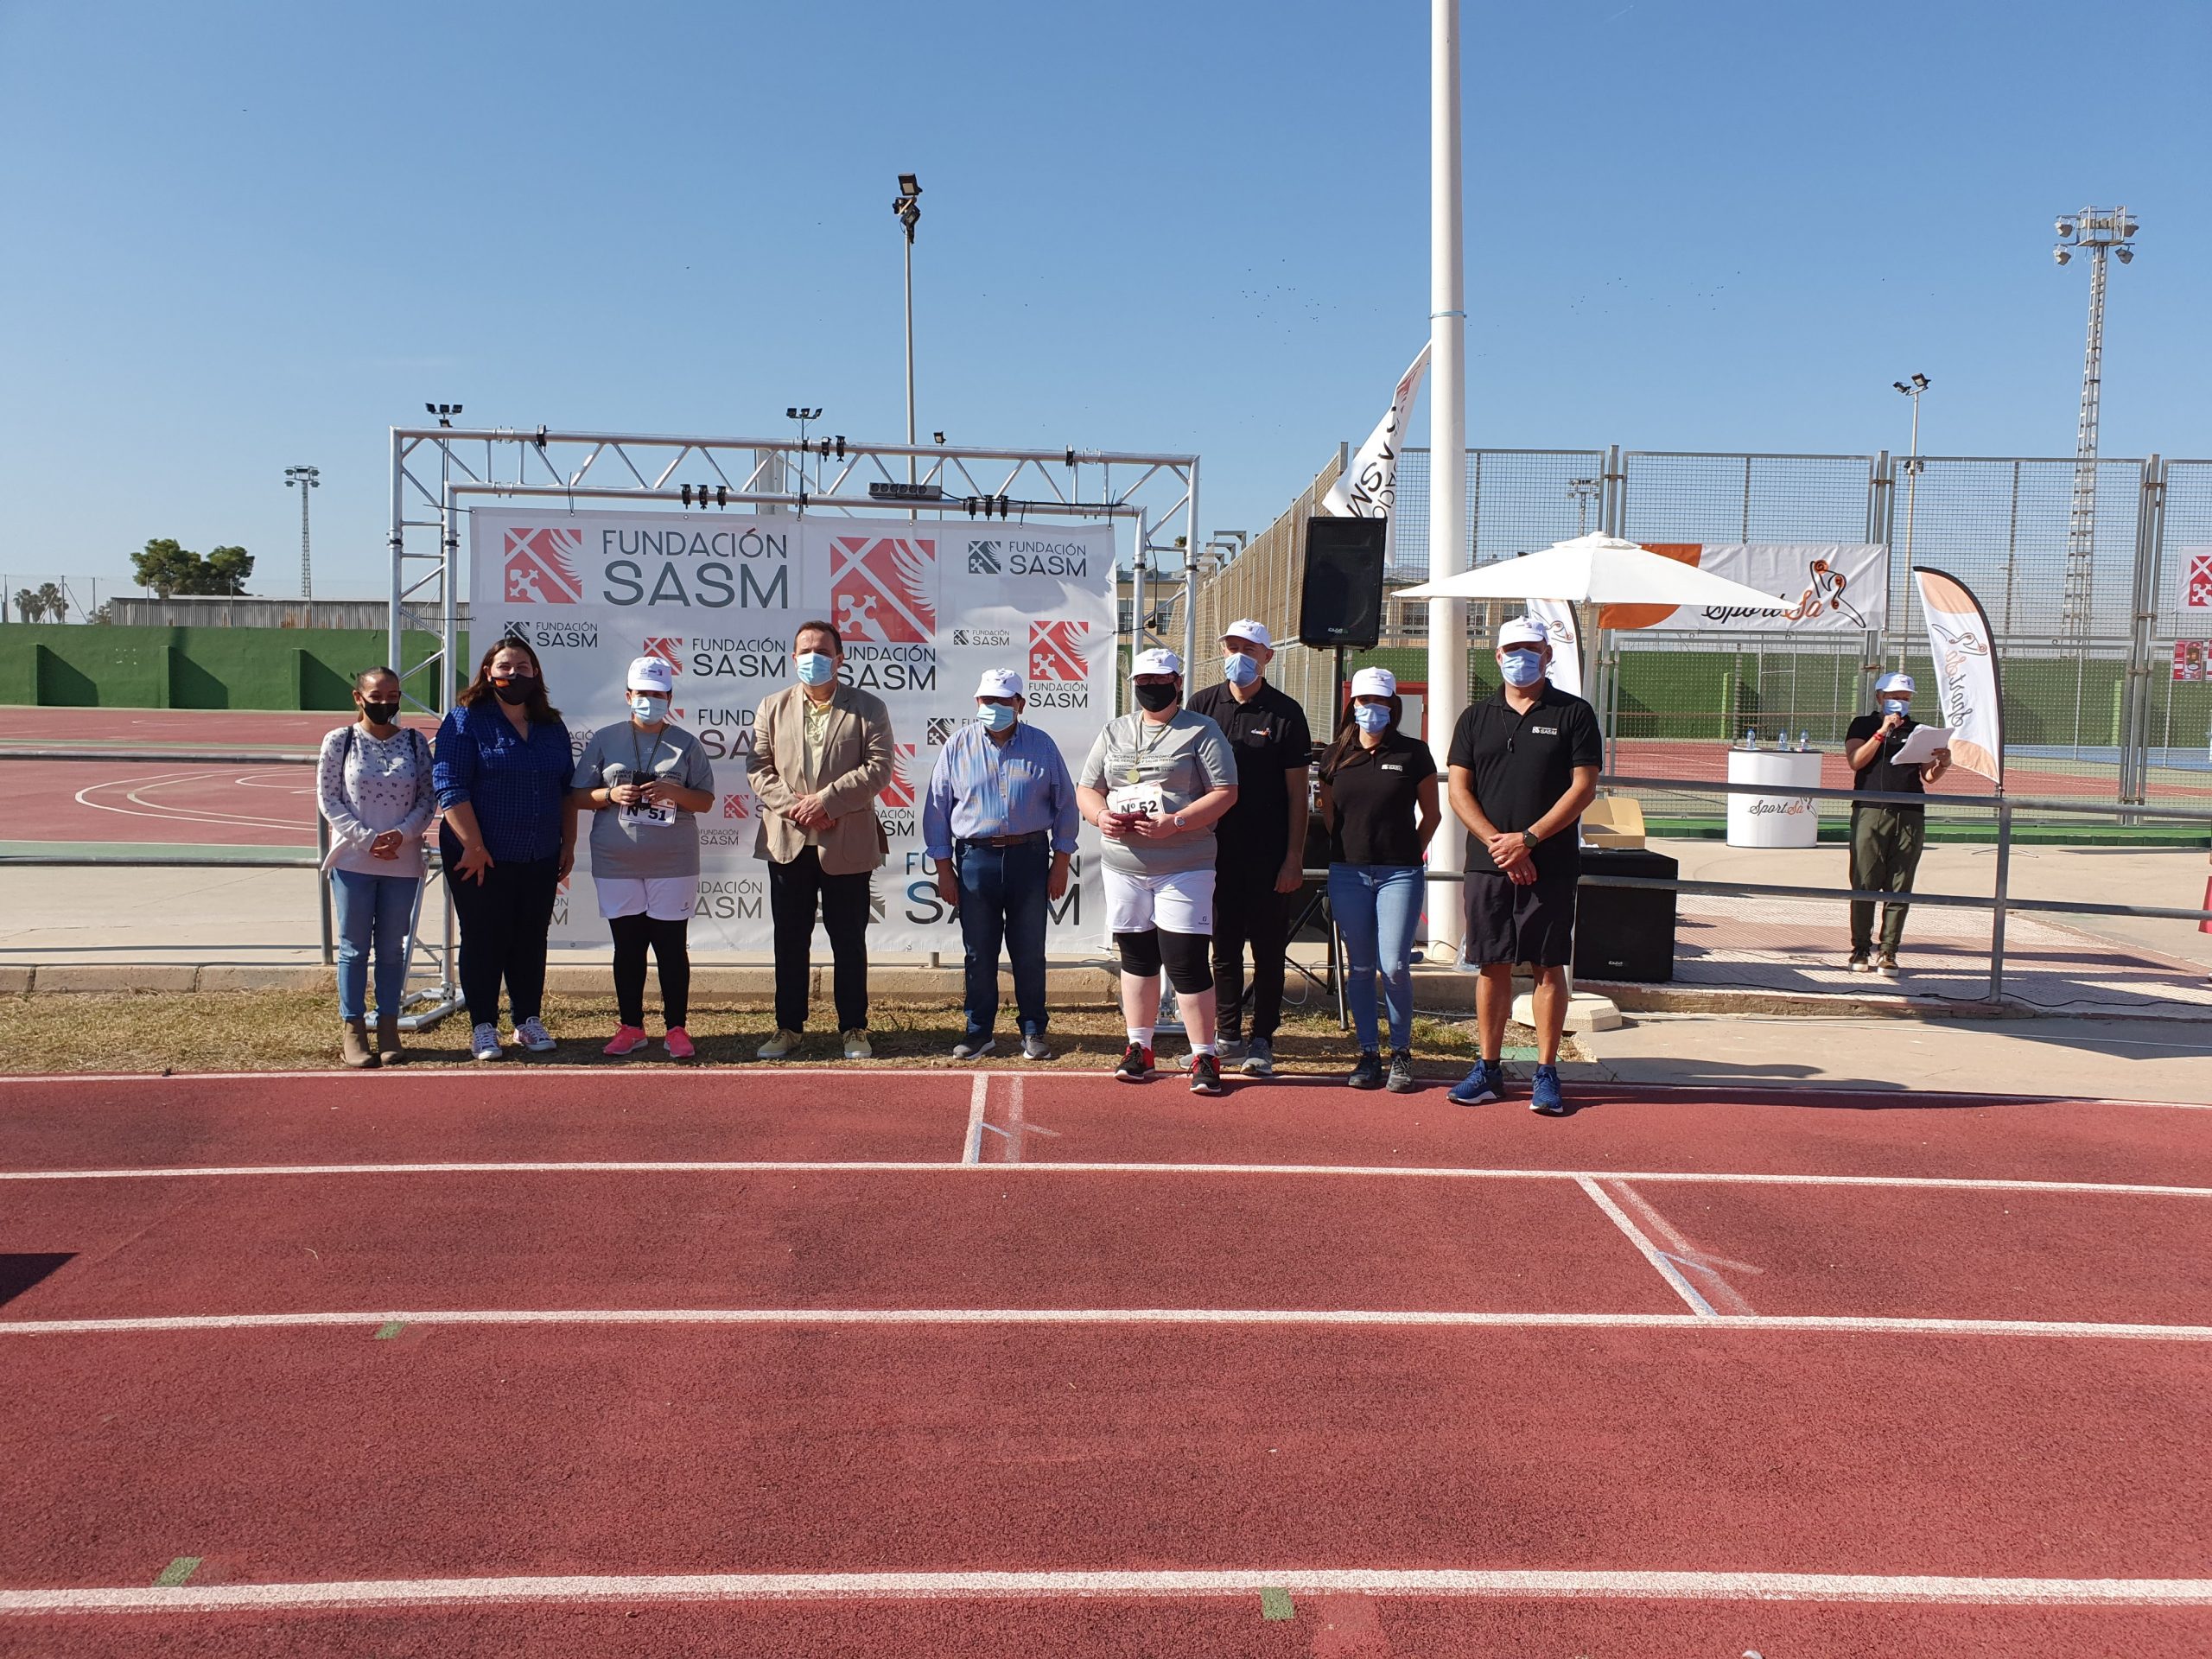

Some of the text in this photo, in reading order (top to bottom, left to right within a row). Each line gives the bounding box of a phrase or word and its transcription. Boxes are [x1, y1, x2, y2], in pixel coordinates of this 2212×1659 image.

[603, 528, 787, 558] FUNDACIÓN
[1009, 541, 1086, 556] FUNDACIÓN
[1009, 555, 1086, 577] SASM
[603, 560, 788, 608] SASM
[536, 621, 598, 632] FUNDACIÓN
[536, 632, 598, 647] SASM
[692, 637, 785, 652] FUNDACIÓN
[972, 636, 1009, 645] SASM
[844, 645, 936, 662] UNDACIÓN
[692, 654, 785, 677] SASM
[837, 664, 936, 690] SASM
[1029, 682, 1088, 691] FUNDACIÓN
[1029, 693, 1088, 708] SASM
[700, 729, 750, 760] SA
[1139, 800, 1158, 813] 52
[648, 808, 666, 821] 51
[882, 820, 914, 836] SM
[700, 836, 739, 845] SASM
[695, 896, 762, 918] ASM
